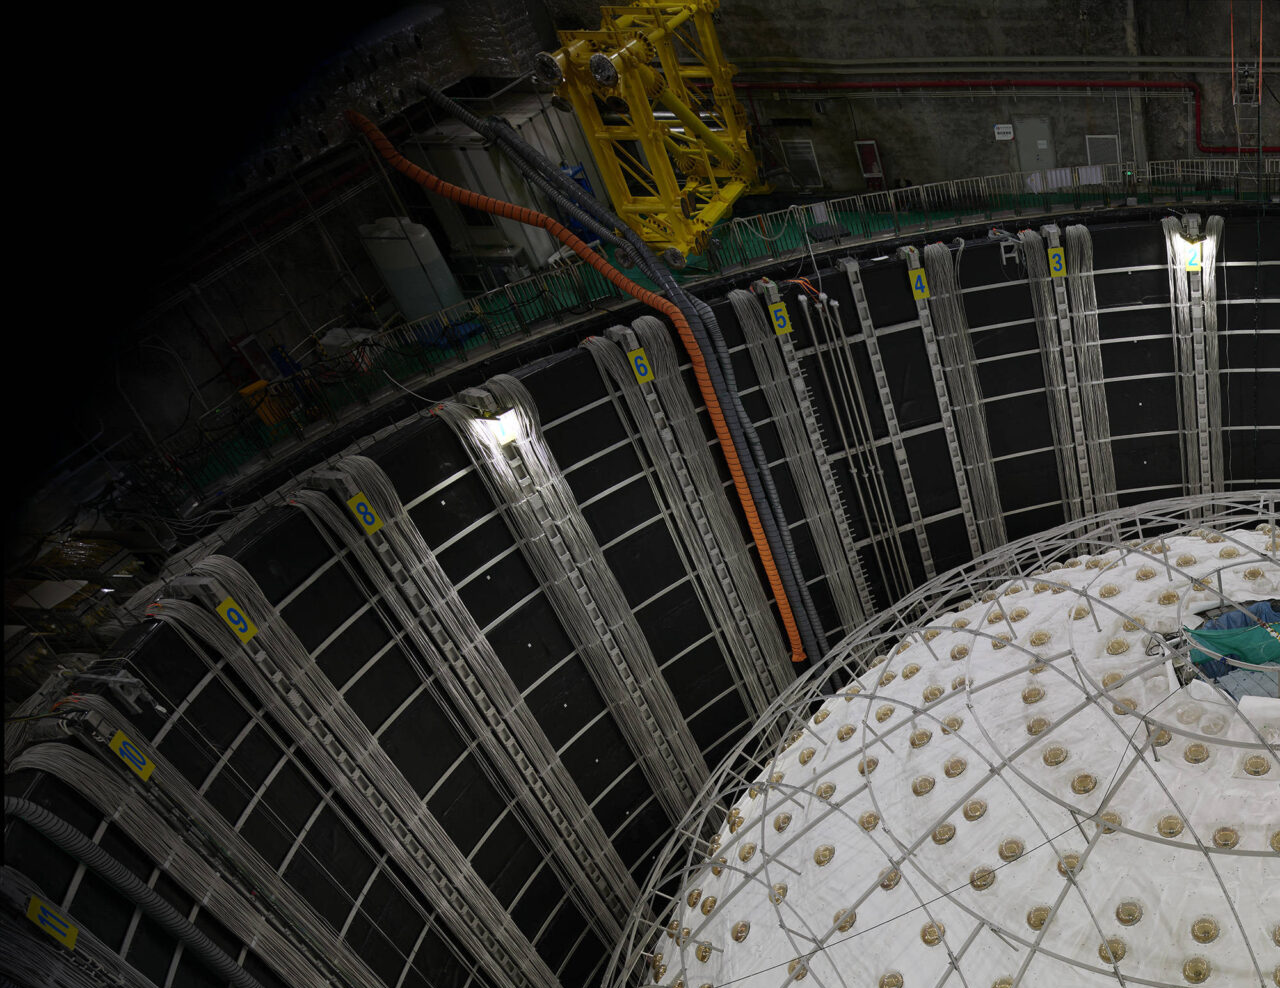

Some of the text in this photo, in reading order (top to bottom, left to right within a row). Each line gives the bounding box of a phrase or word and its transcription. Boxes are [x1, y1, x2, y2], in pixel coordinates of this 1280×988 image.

[1051, 253, 1063, 272] 3
[1188, 250, 1198, 266] 2
[914, 274, 926, 293] 4
[773, 309, 787, 329] 5
[634, 355, 648, 377] 6
[356, 503, 375, 525] 8
[226, 607, 247, 632] 9
[119, 741, 147, 770] 10
[38, 906, 69, 937] 11
